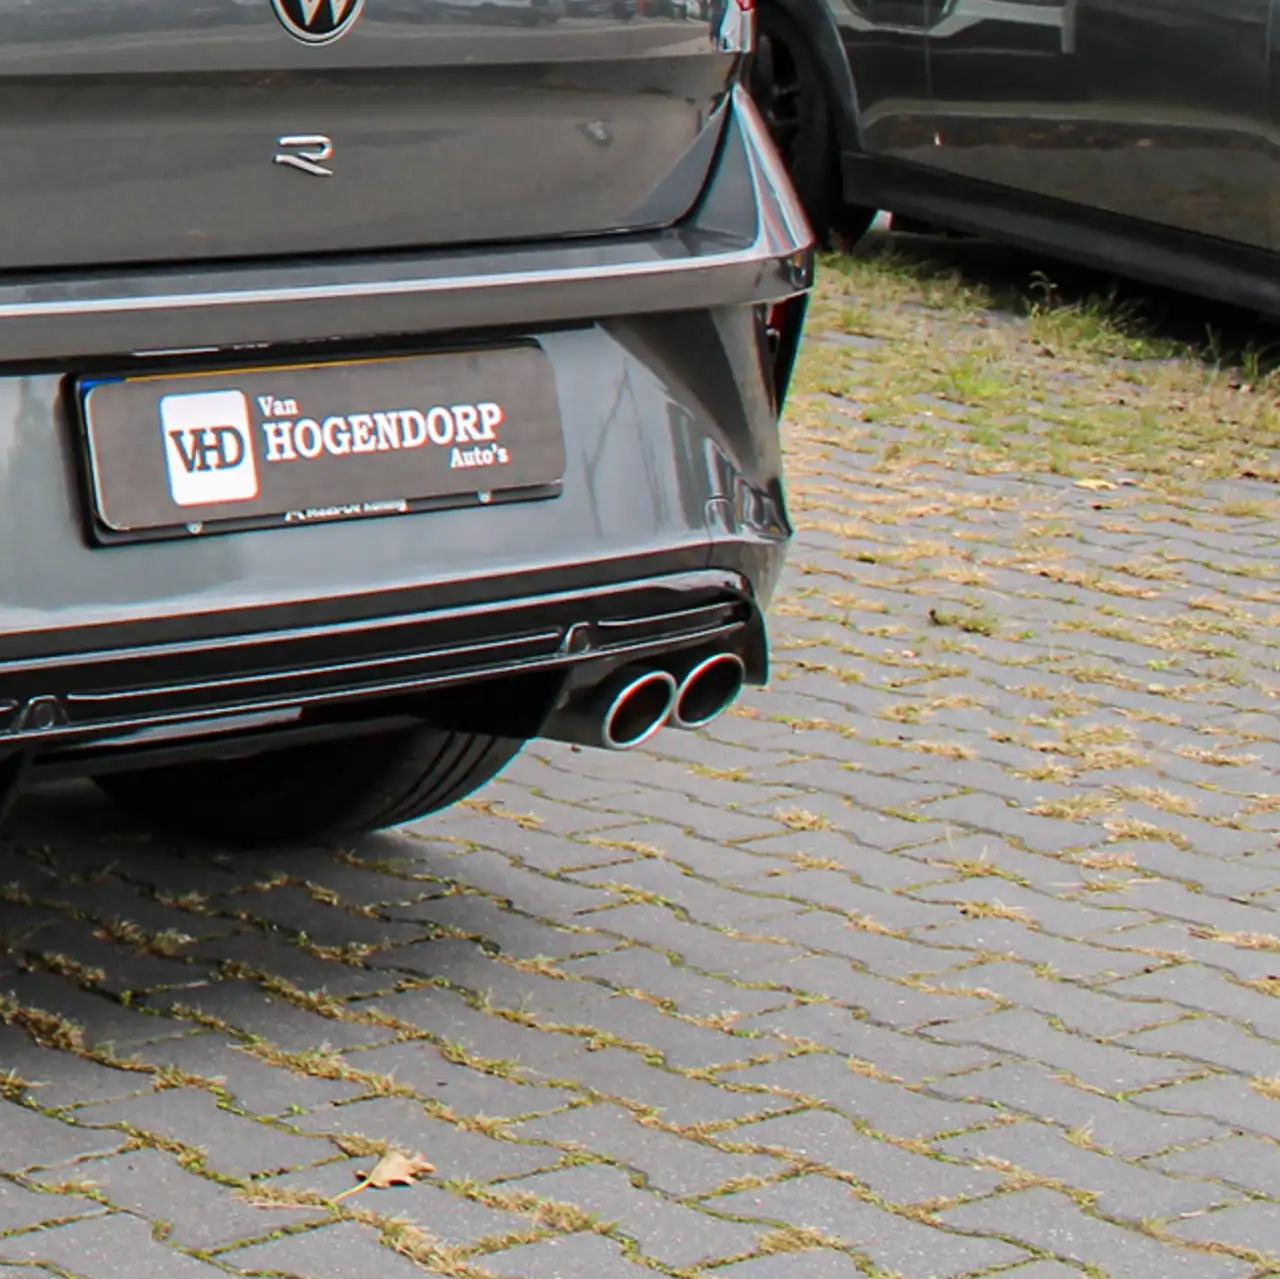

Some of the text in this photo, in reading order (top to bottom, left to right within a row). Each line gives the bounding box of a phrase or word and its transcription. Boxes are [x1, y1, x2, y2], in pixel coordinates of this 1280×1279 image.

[257, 395, 299, 417] Van
[169, 426, 246, 474] VHD
[262, 401, 504, 462] HOGENDORP
[450, 443, 510, 469] Auto's
